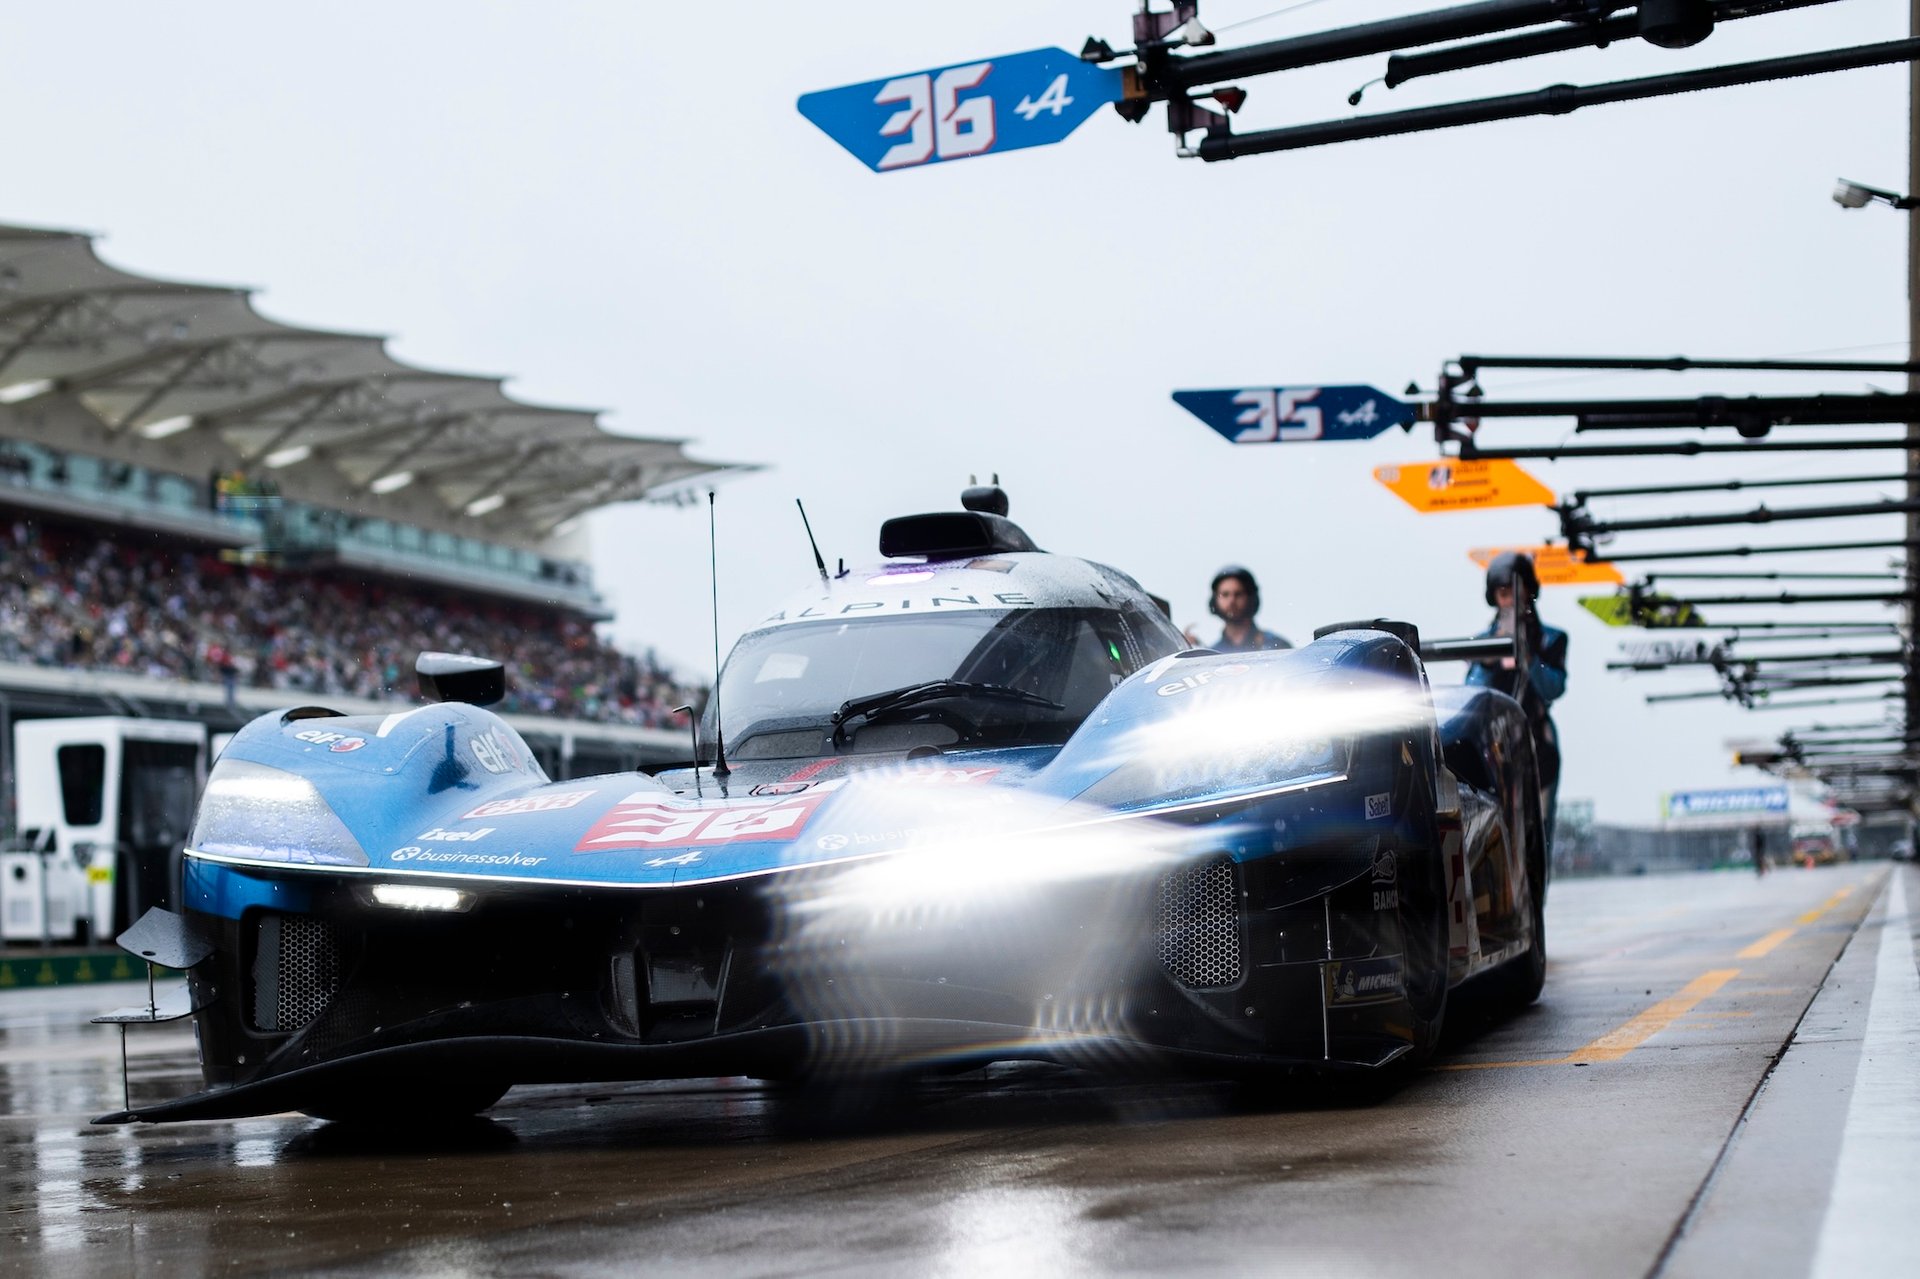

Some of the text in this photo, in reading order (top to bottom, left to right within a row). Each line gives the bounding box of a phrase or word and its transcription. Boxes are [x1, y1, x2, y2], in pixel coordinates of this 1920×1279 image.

[873, 62, 996, 169] 36
[1232, 388, 1322, 442] 35
[760, 593, 1034, 625] ALPINE
[1157, 672, 1215, 696] elf
[295, 730, 343, 745] elf
[586, 793, 826, 844] 36
[417, 828, 496, 842] ixell
[416, 848, 547, 866] businessolver
